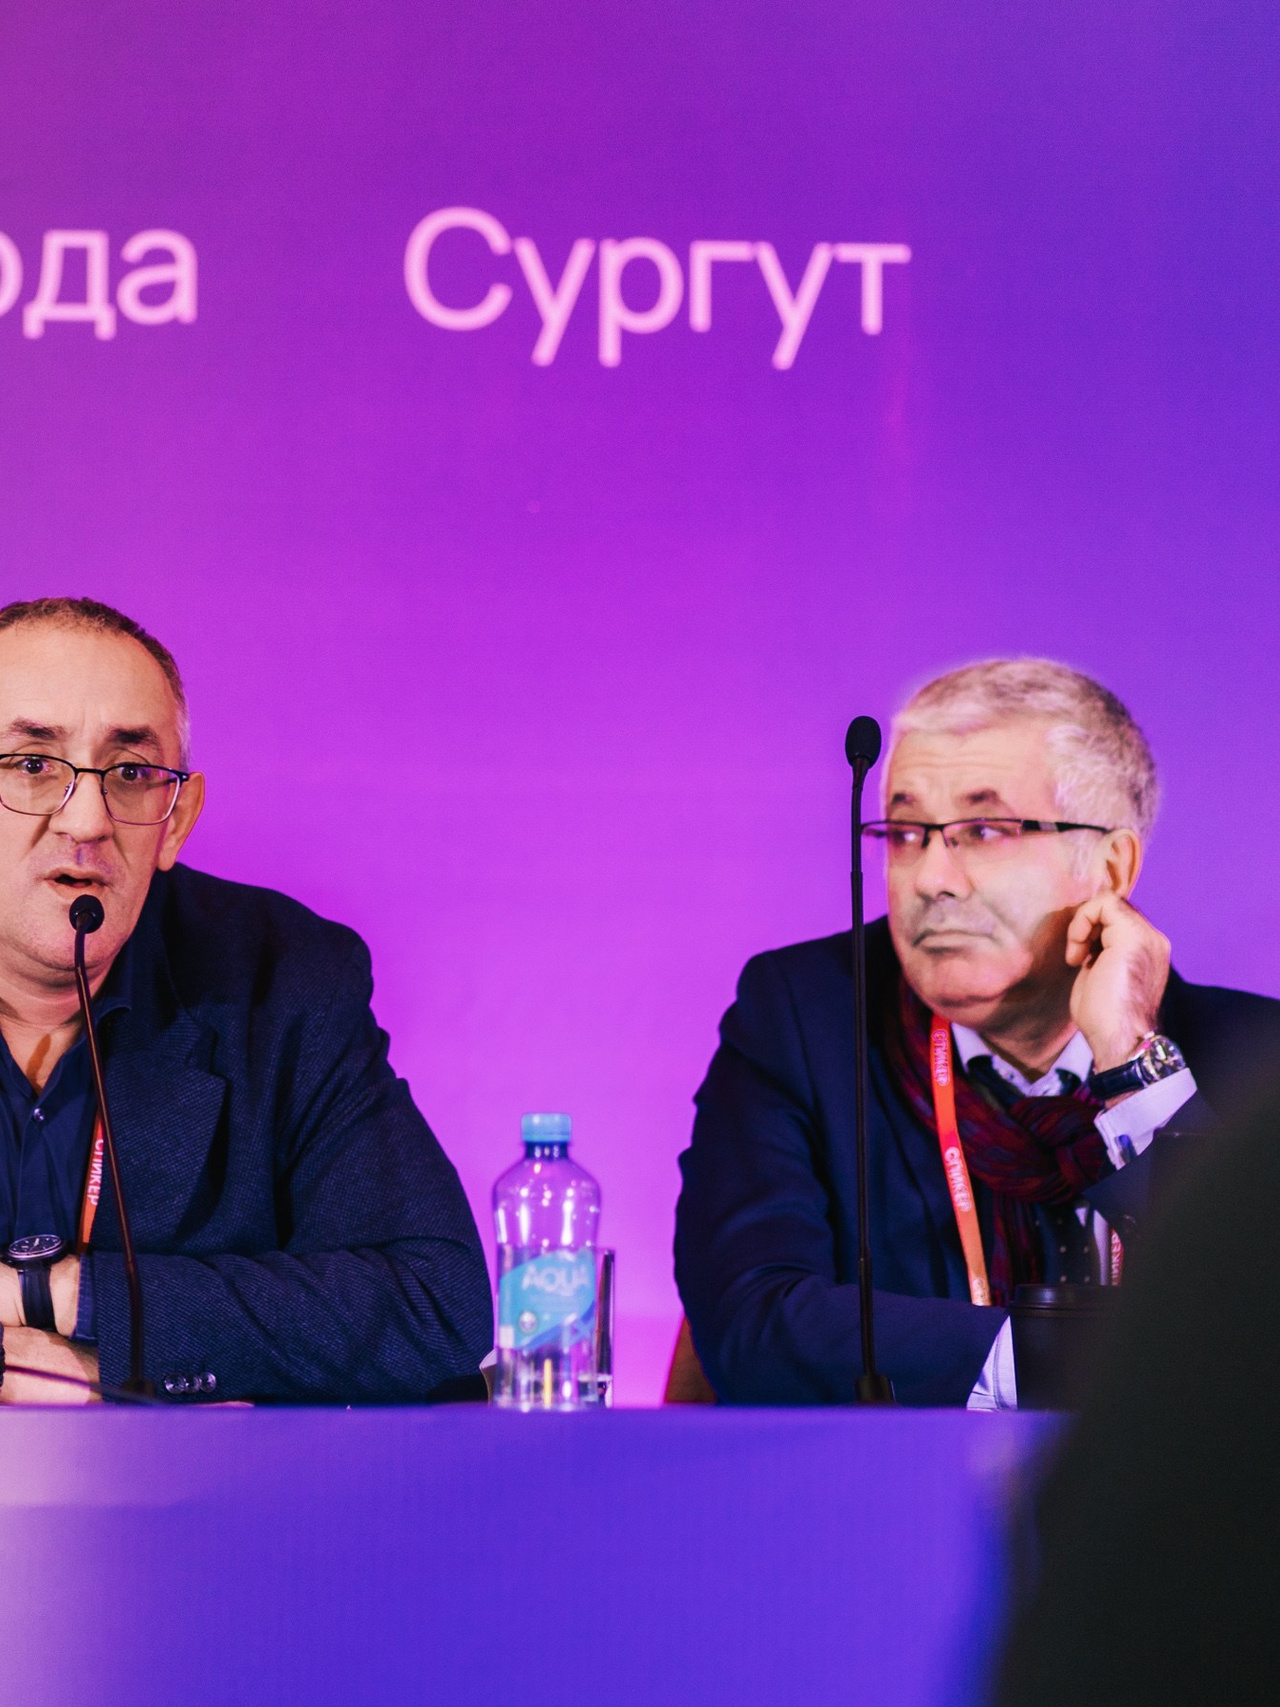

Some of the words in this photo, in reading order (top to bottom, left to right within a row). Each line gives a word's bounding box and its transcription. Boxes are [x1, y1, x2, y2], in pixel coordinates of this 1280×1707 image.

[403, 205, 912, 371] Сургут
[931, 1028, 950, 1087] СПИКЕР
[86, 1138, 105, 1207] СПИКЕР
[944, 1146, 972, 1212] СПИКЕР
